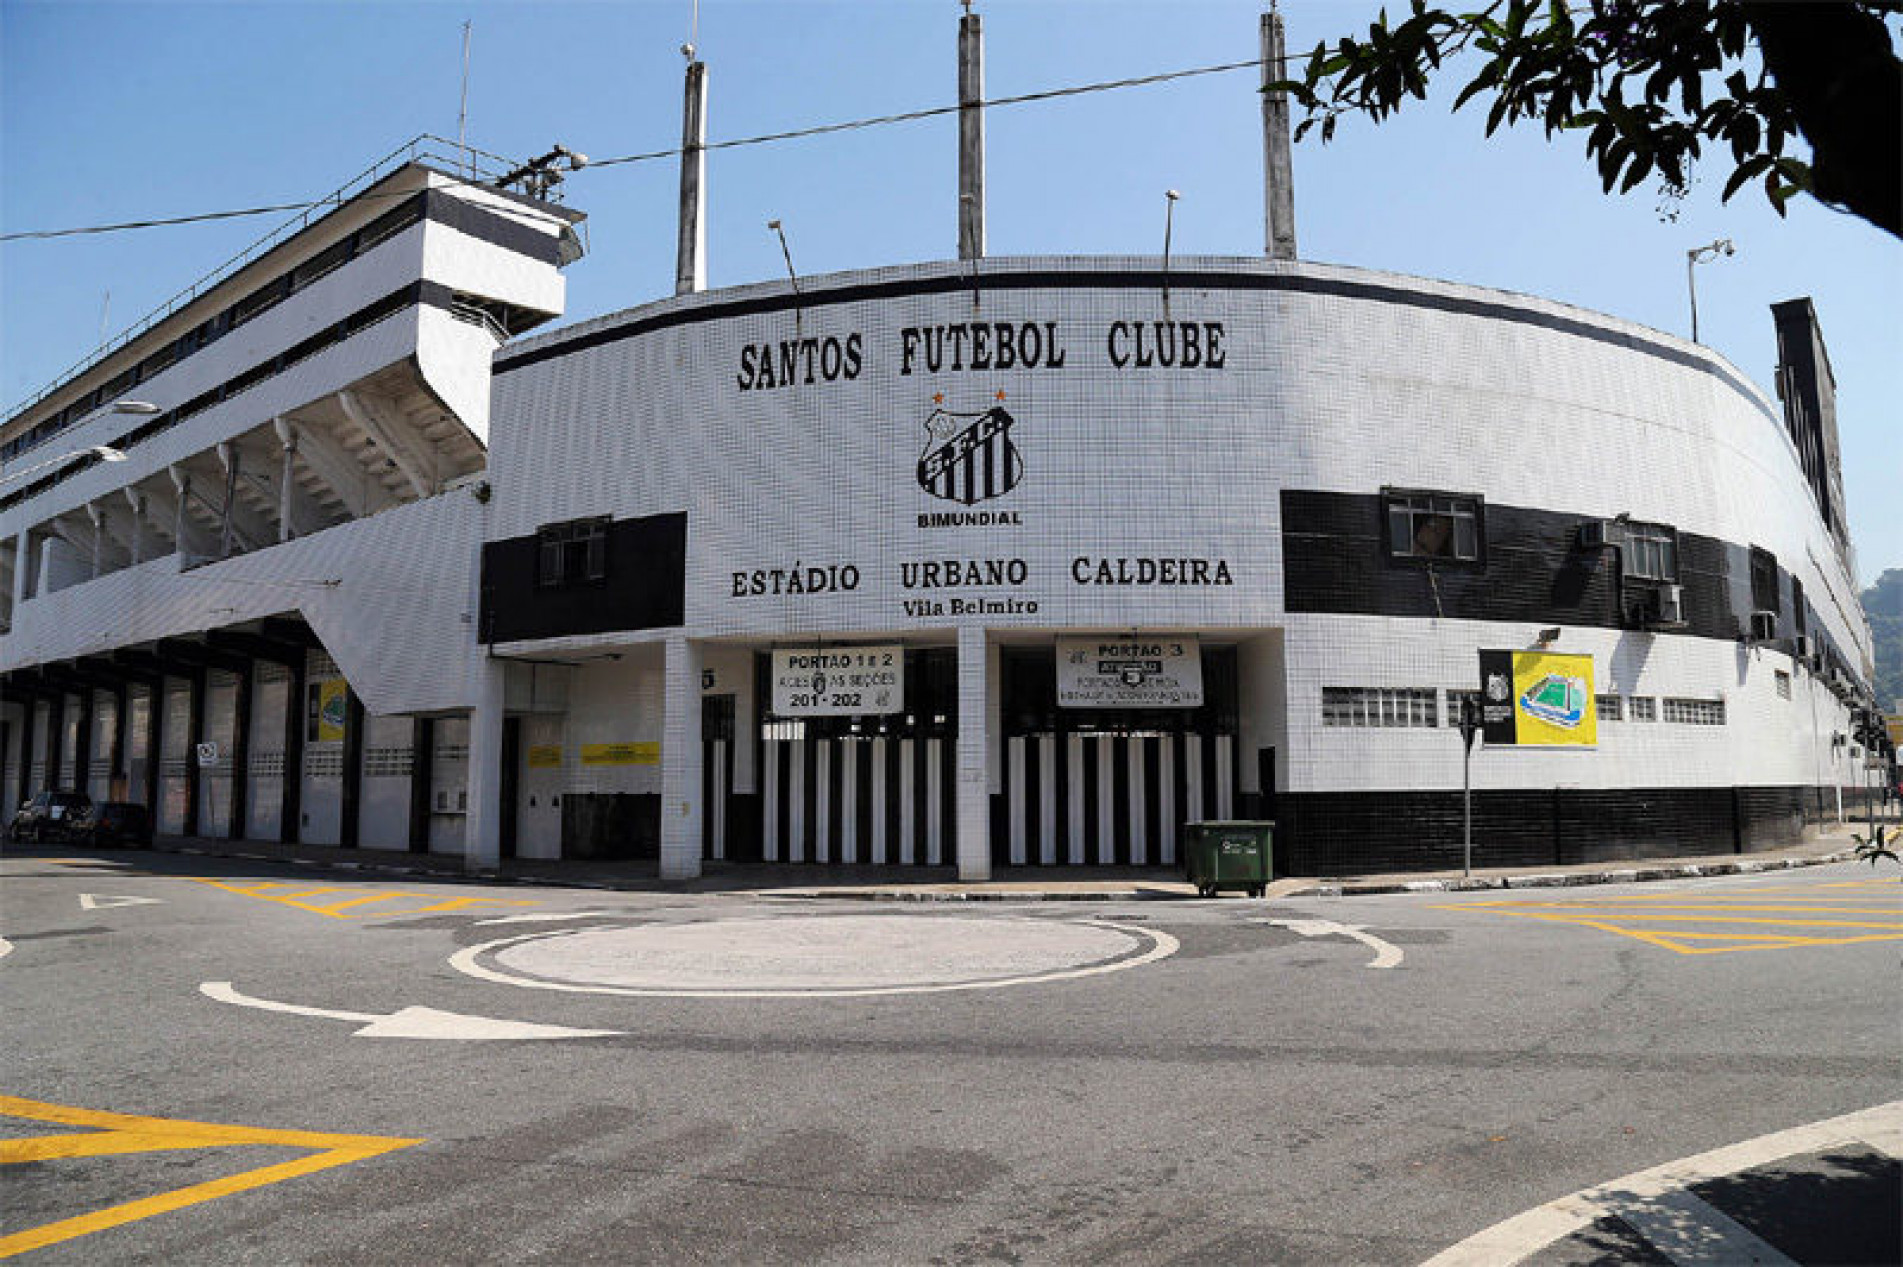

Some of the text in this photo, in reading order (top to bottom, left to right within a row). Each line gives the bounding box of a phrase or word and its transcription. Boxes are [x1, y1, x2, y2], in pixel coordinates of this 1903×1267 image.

[737, 321, 1226, 391] SANTOS FUTEBOL CLUBE
[917, 511, 1023, 528] BIMUNDIAL
[732, 556, 1233, 597] ESTÁDIO URBANO CALDEIRA
[903, 598, 1038, 617] Vila Belmiro
[1170, 644, 1183, 657] 3
[882, 653, 892, 666] 2
[789, 694, 818, 707] 201
[832, 694, 861, 707] 202
